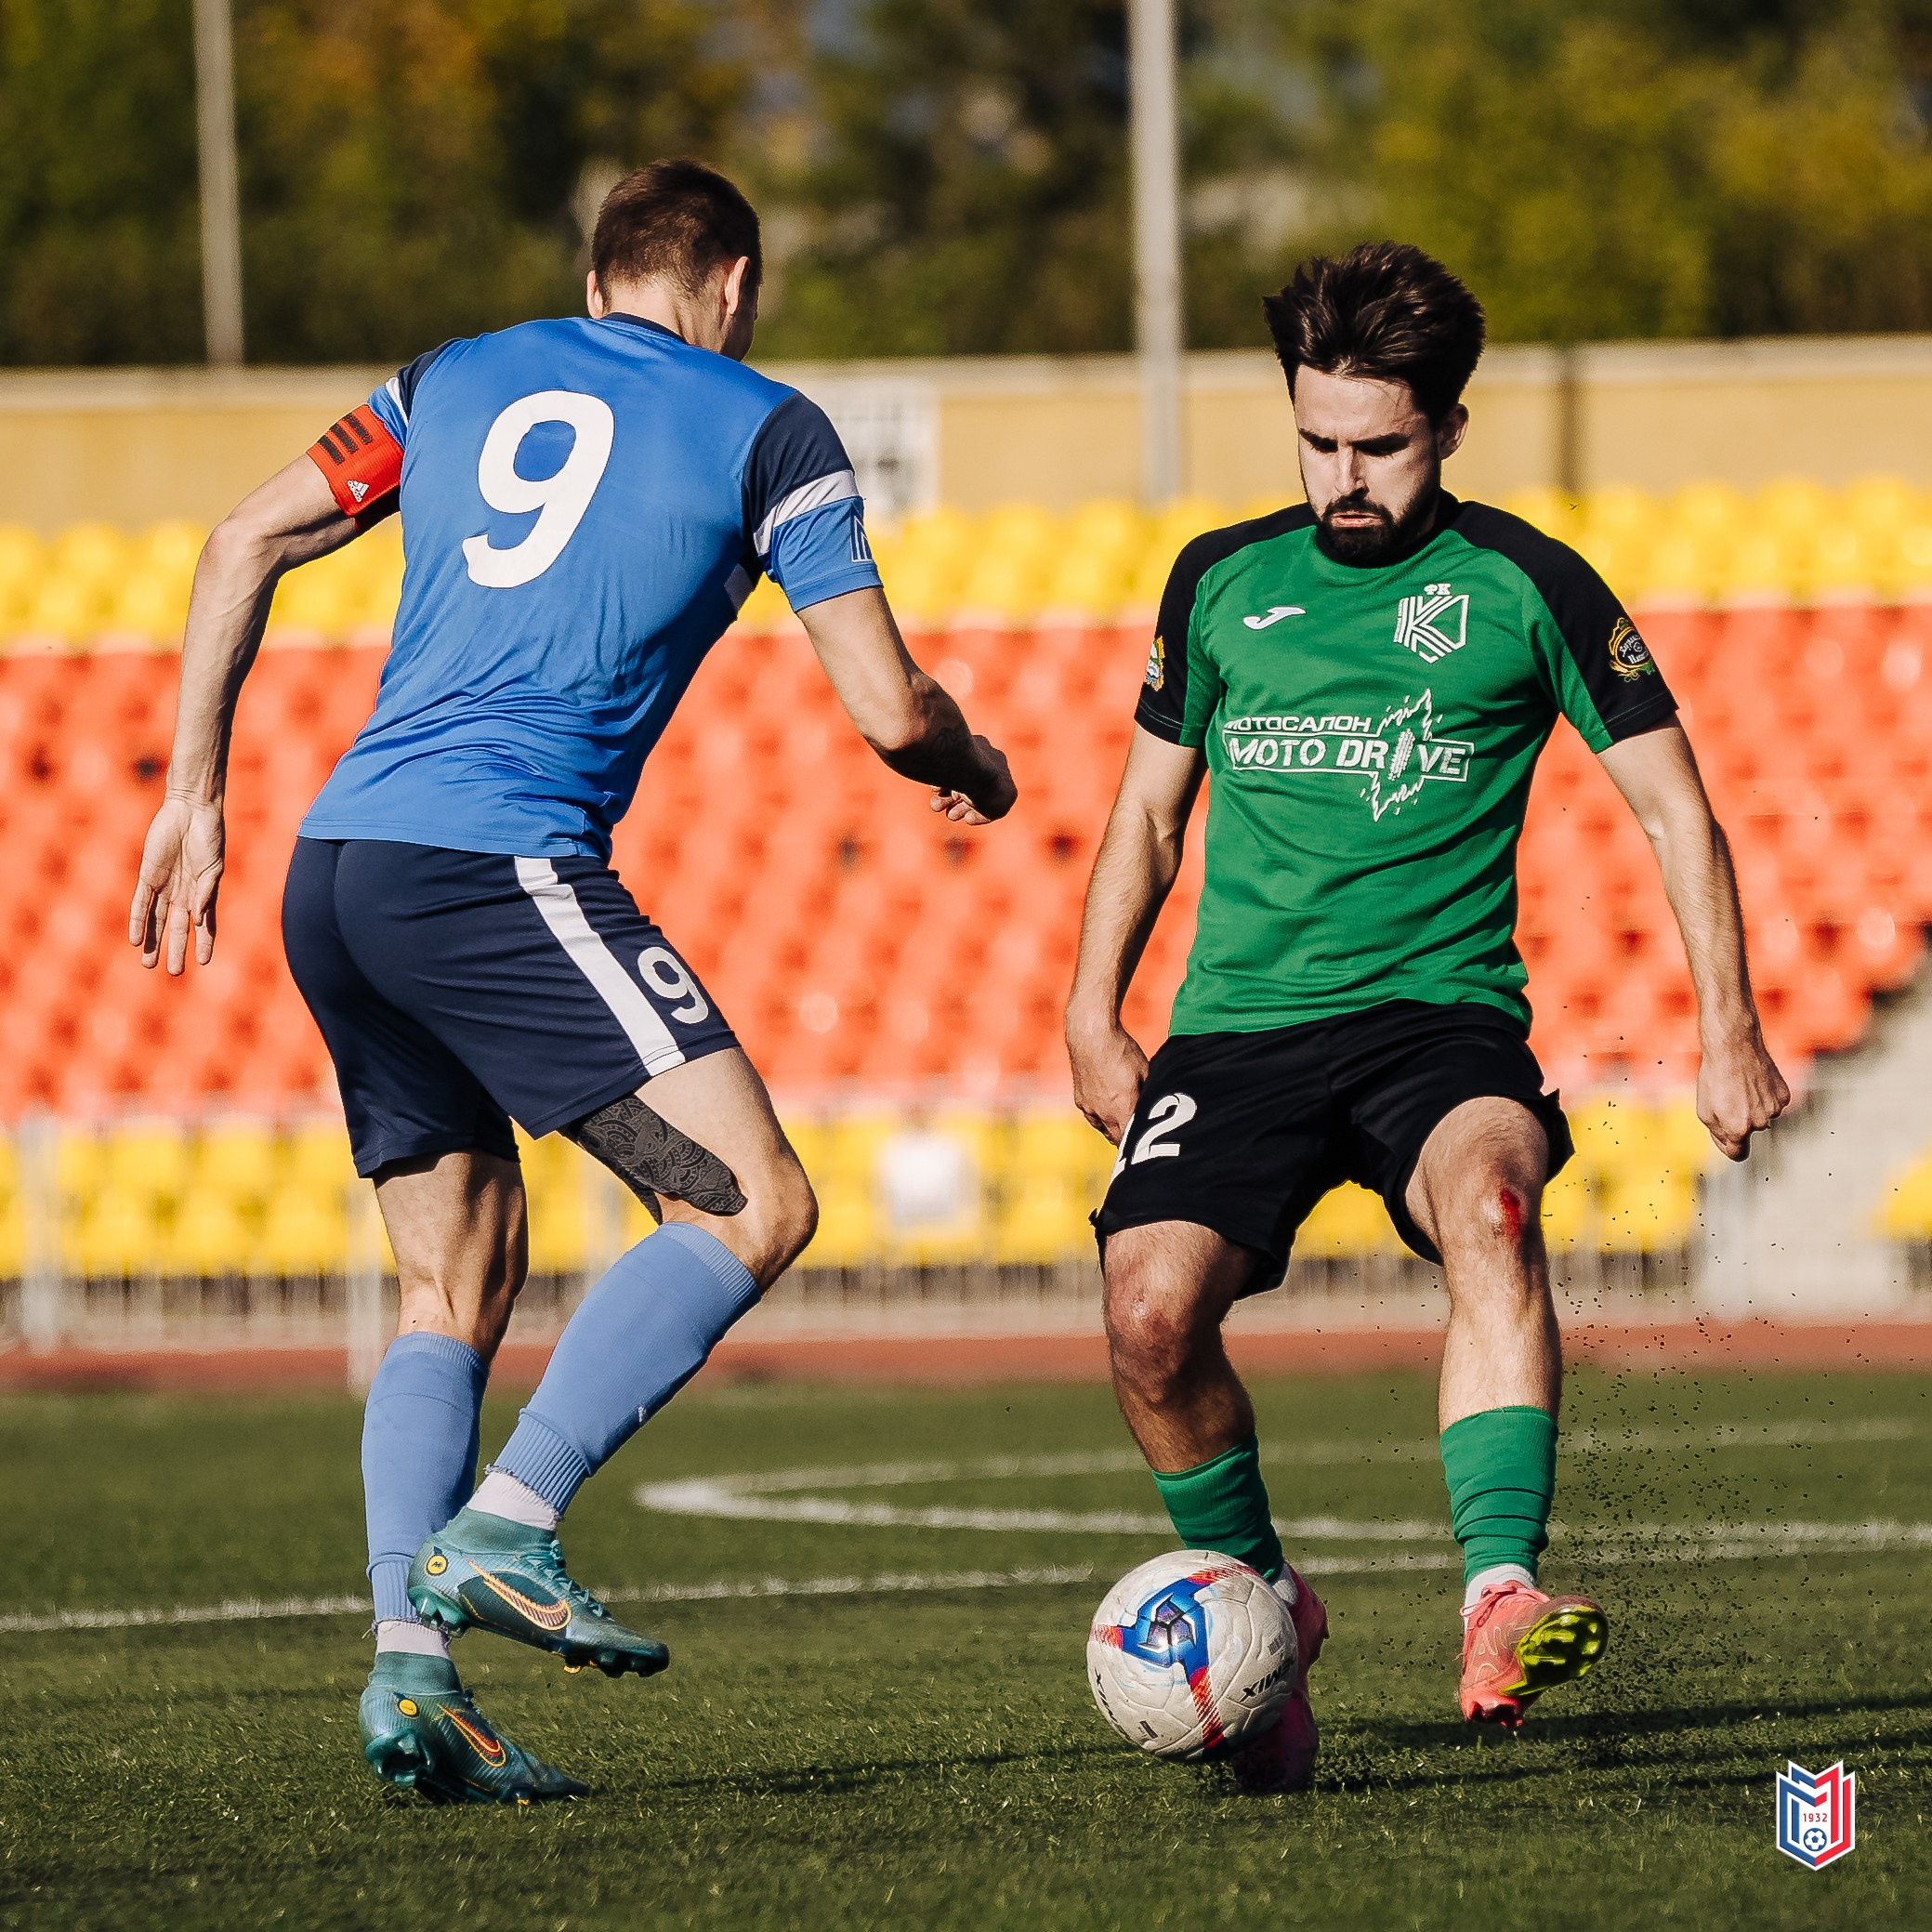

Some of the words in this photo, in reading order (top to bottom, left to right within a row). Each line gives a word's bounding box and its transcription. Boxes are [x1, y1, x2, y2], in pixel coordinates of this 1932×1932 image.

[462, 389, 614, 588] 9
[1229, 737, 1327, 767] MOTO
[637, 946, 708, 1024] 9
